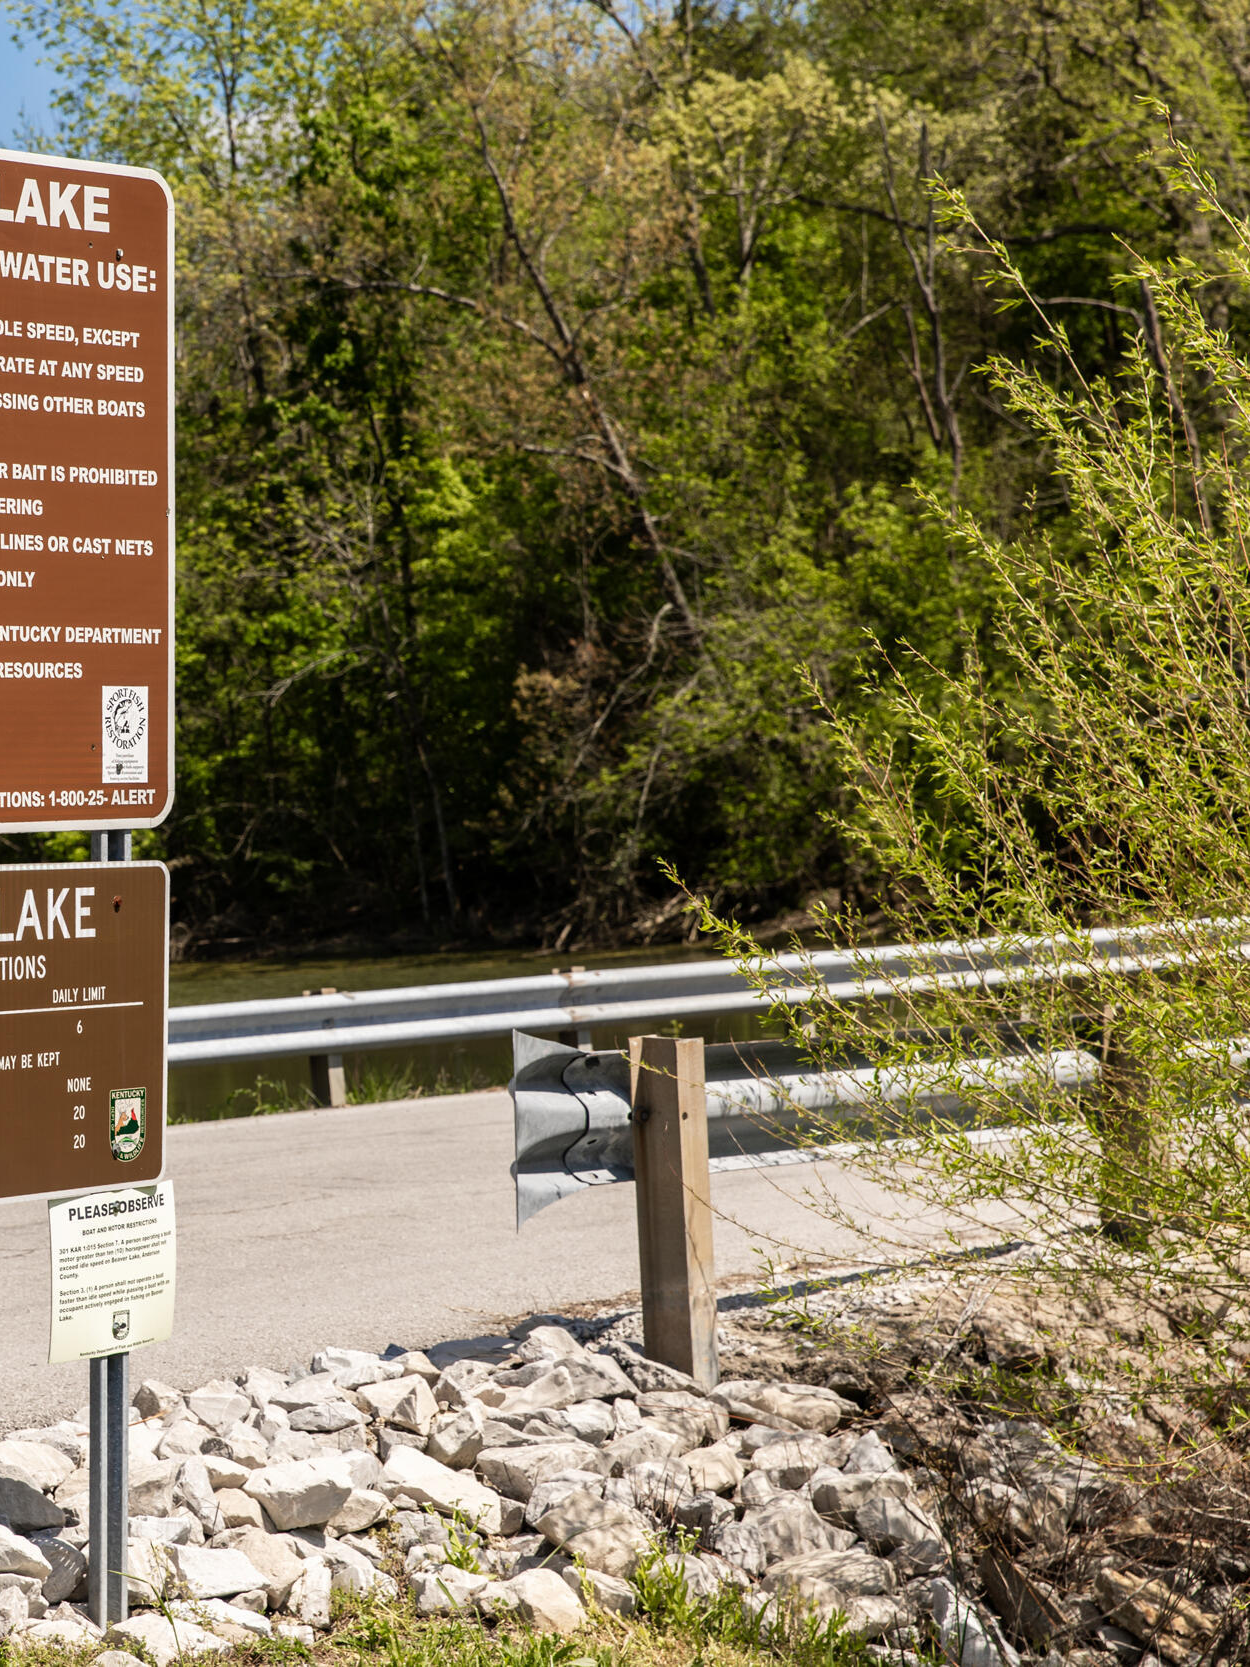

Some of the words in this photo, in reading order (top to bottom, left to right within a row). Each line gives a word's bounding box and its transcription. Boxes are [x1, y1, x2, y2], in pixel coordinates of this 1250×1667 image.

[97, 261, 156, 293] USE:
[27, 322, 79, 346] SPEED,
[83, 328, 140, 348] EXCEPT
[38, 360, 58, 376] AT
[61, 361, 93, 379] ANY
[97, 364, 144, 382] SPEED
[43, 396, 94, 415] OTHER
[98, 400, 145, 418] BOATS
[12, 464, 47, 481] BAIT
[51, 466, 65, 482] IS
[69, 467, 158, 486] PROHIBITED
[0, 533, 44, 551] LINES
[48, 536, 69, 552] OR
[73, 537, 111, 554] CAST
[115, 539, 153, 556] NETS
[65, 627, 162, 644] DEPARTMENT
[107, 688, 128, 712] SPORT
[129, 689, 145, 712] FISH
[105, 717, 146, 750] RESTORATION
[111, 789, 156, 805] ALERT
[53, 988, 78, 1003] DAILY
[83, 986, 106, 1001] LIMIT
[77, 1020, 83, 1034] 6
[21, 1054, 33, 1069] BE
[37, 1051, 60, 1067] KEPT
[67, 1077, 91, 1092] NONE
[112, 1090, 144, 1099] KENTUCKY
[73, 1105, 85, 1120] 20
[74, 1134, 85, 1149] 20
[69, 1203, 114, 1221] PLEASE
[118, 1193, 164, 1213] OBSERVE
[108, 1223, 125, 1231] MOTOR
[126, 1218, 157, 1228] RESTRICTIONS
[76, 1253, 94, 1263] greater
